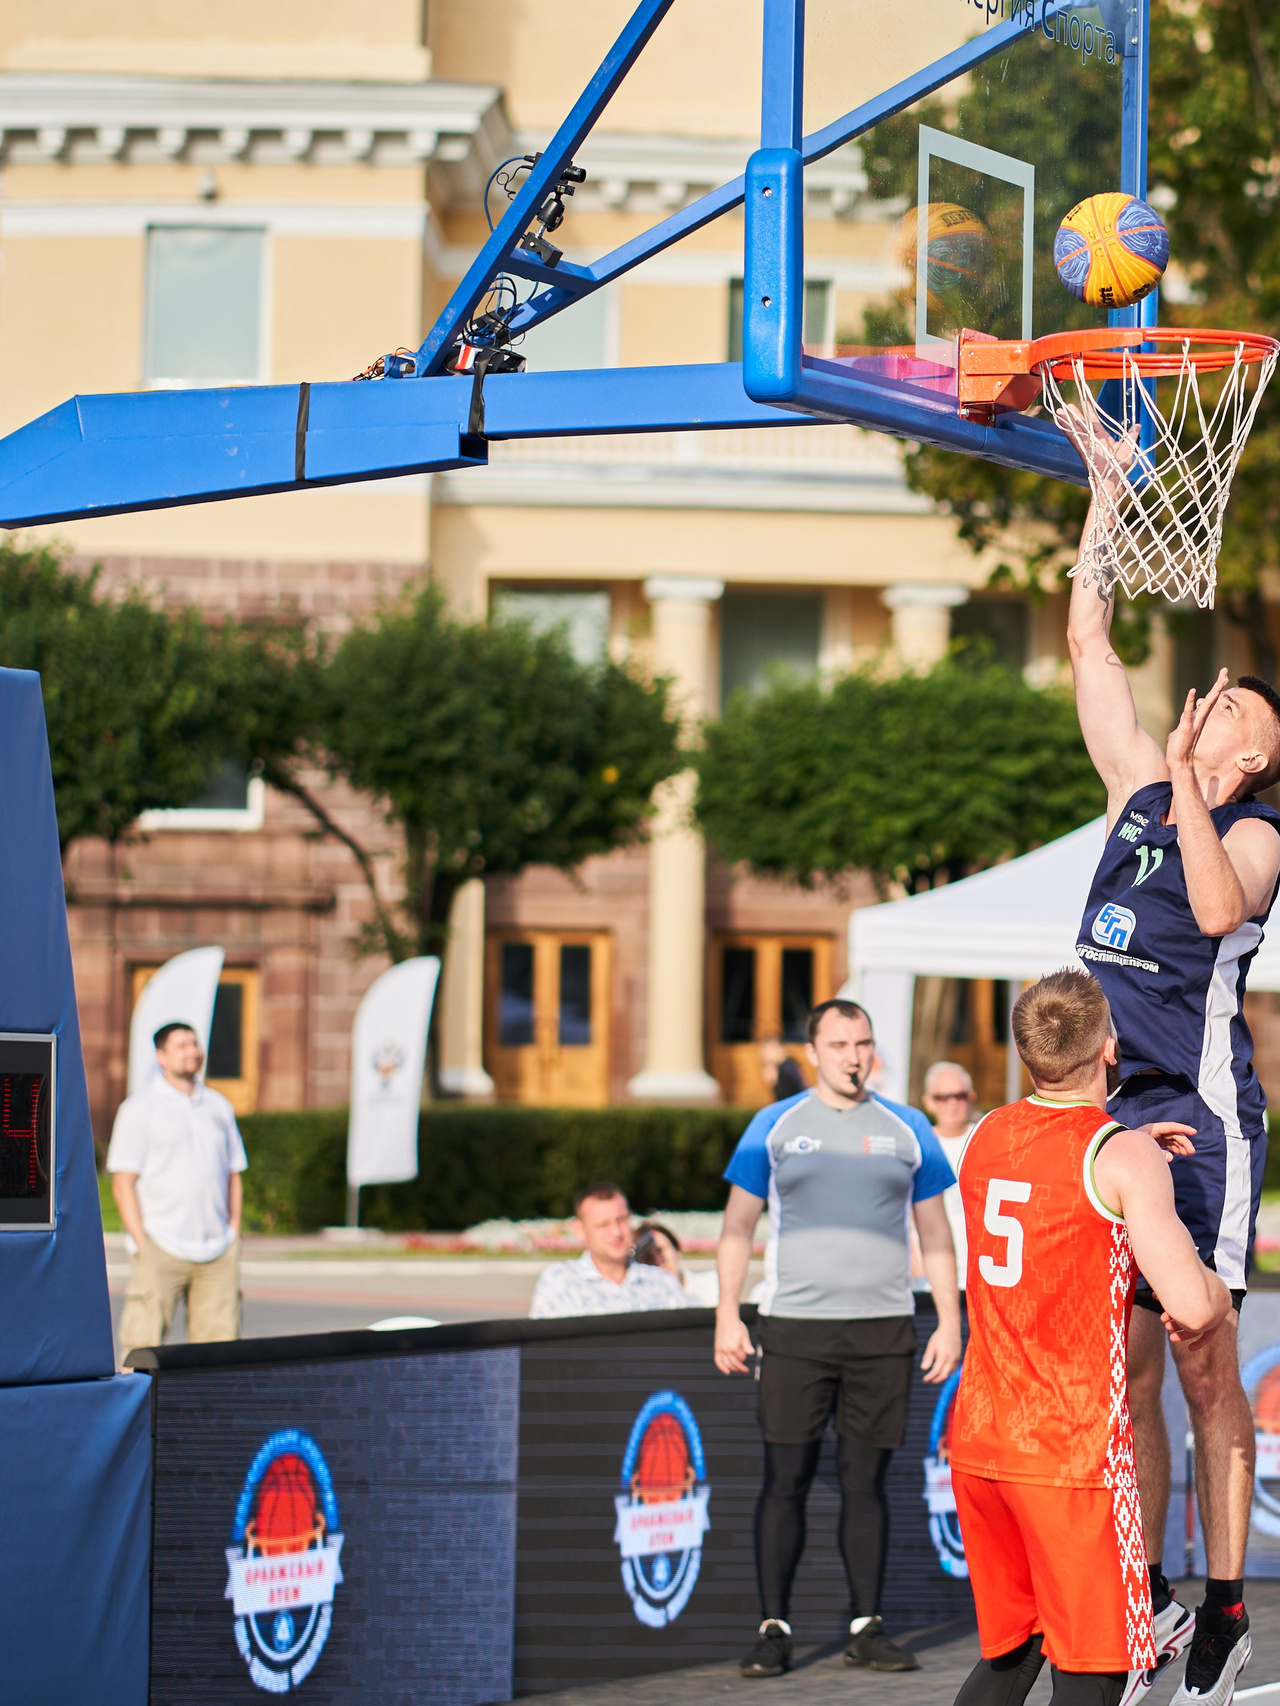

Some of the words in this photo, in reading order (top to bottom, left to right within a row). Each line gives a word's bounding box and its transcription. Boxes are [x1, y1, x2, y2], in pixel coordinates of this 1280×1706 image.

[1041, 0, 1117, 65] Спорта
[1130, 845, 1164, 888] 11
[1098, 904, 1128, 949] БГП
[978, 1178, 1032, 1288] 5
